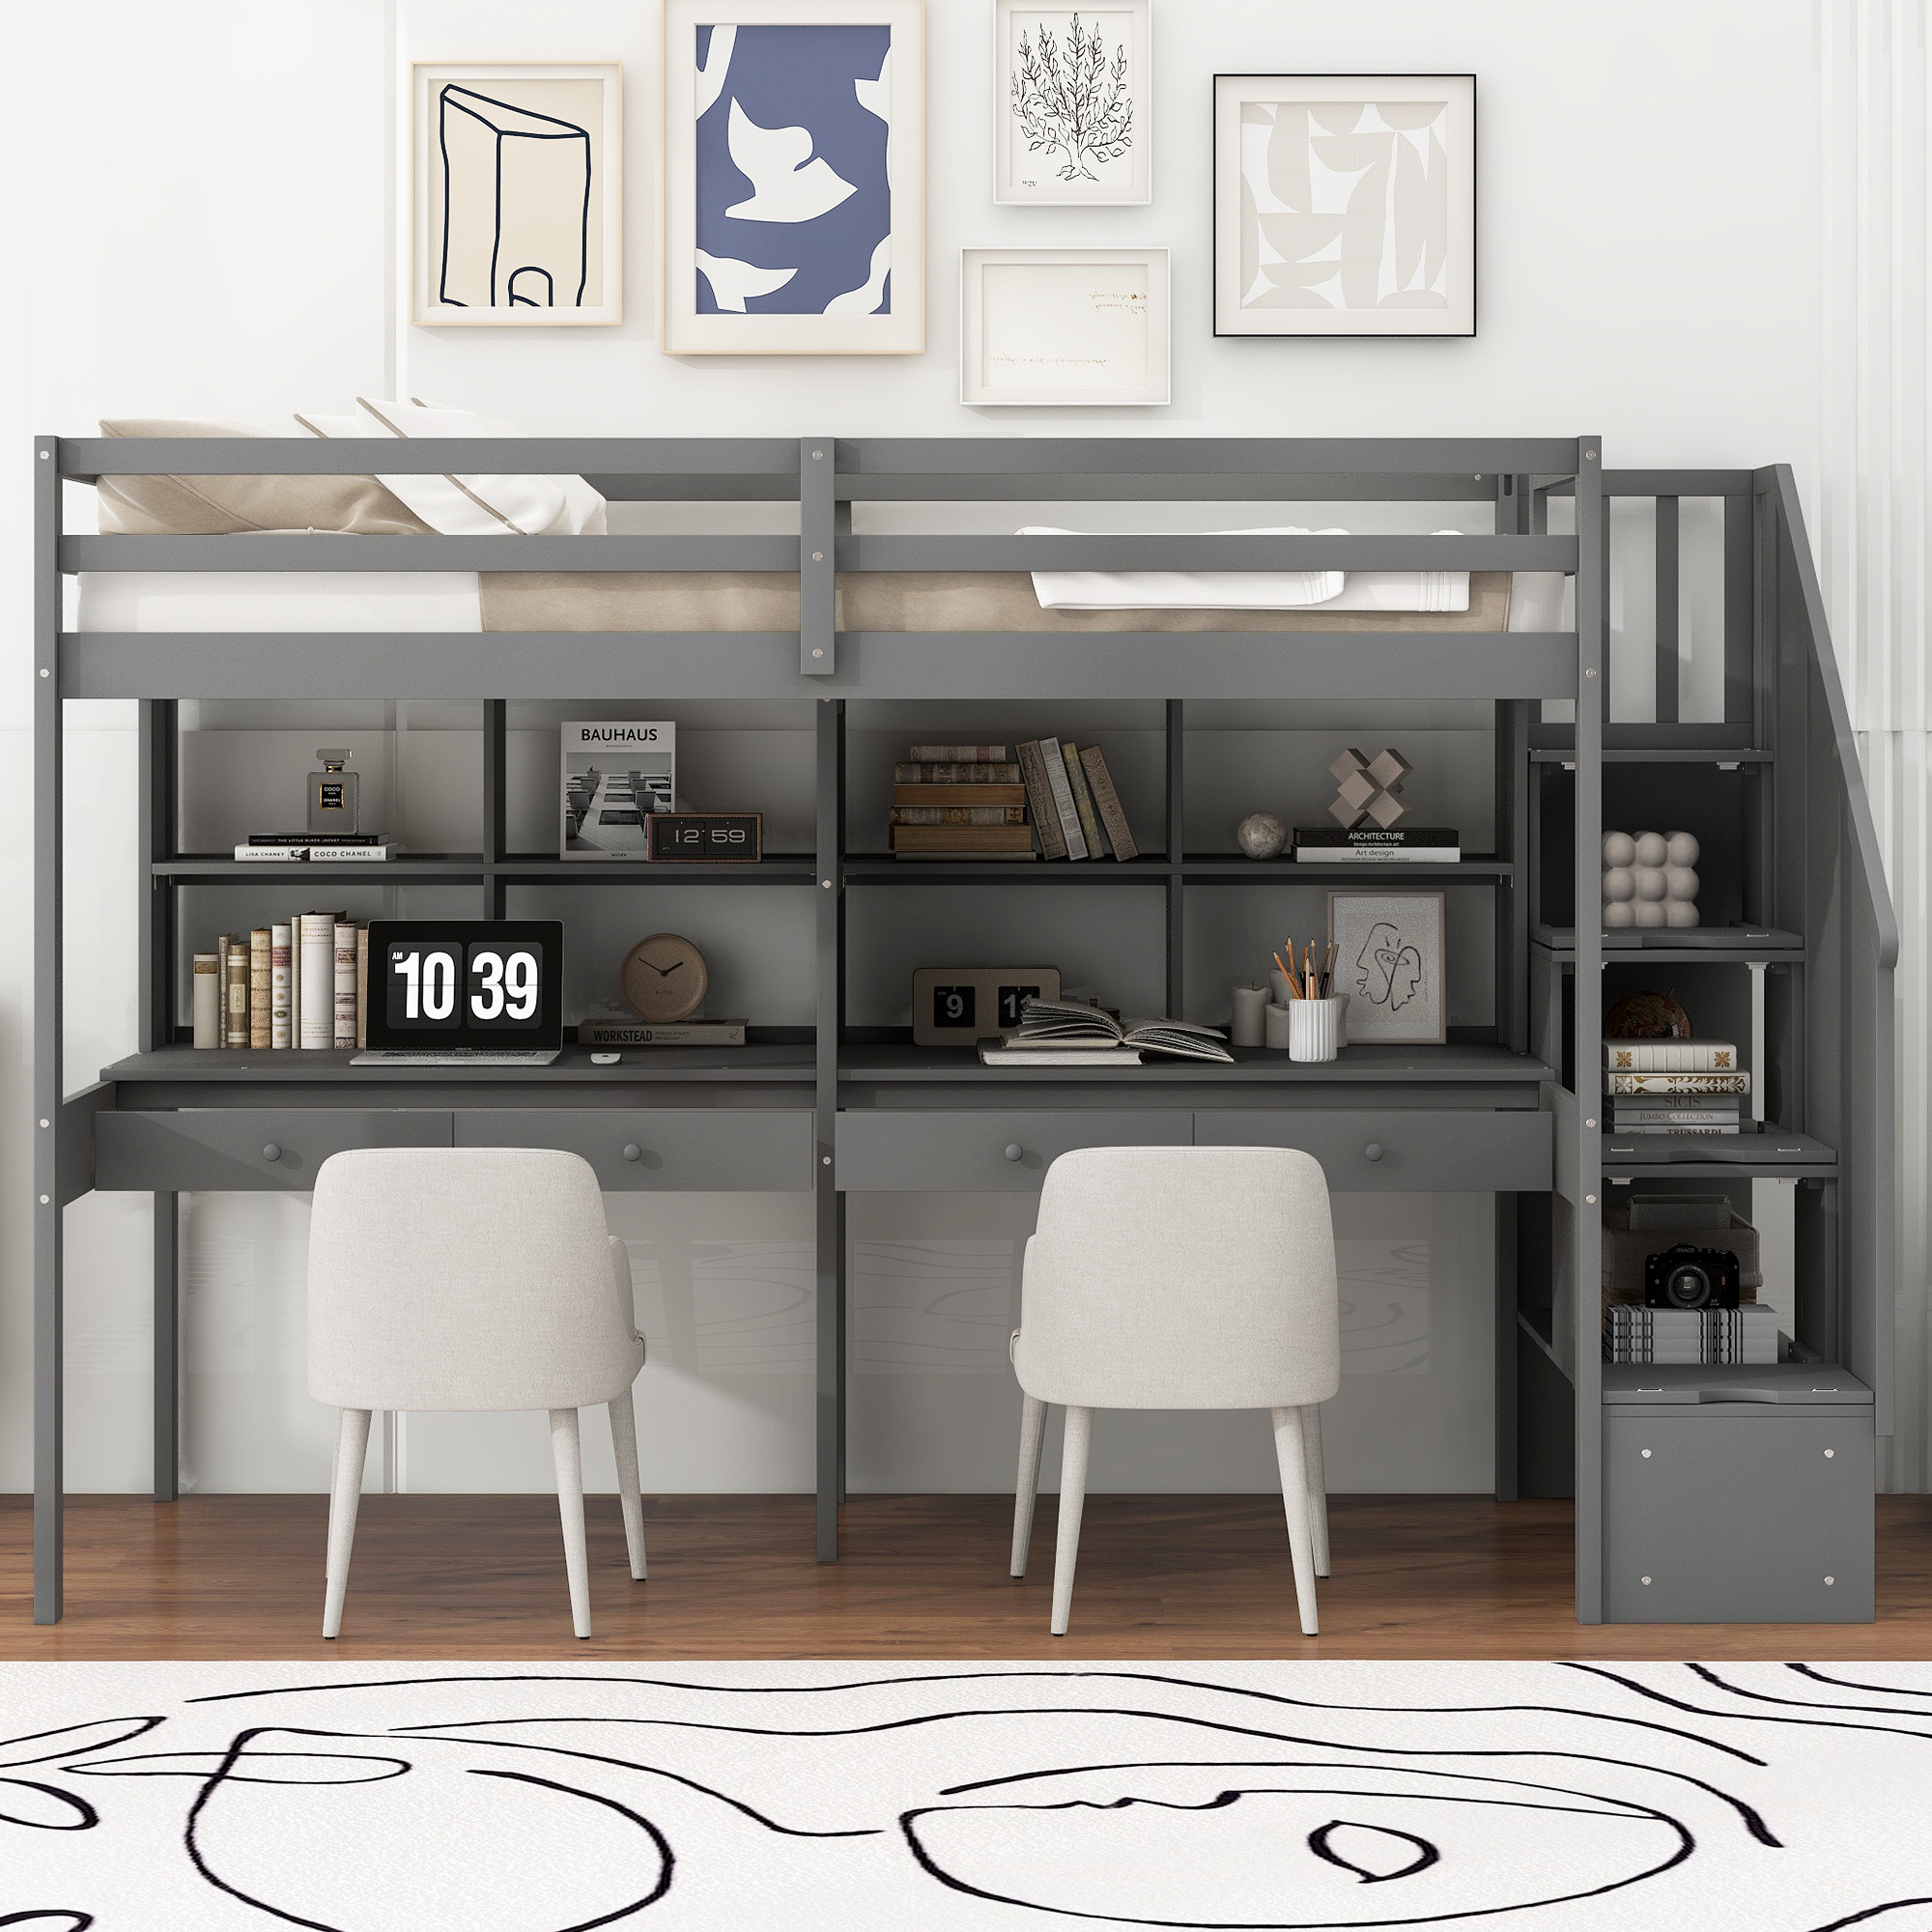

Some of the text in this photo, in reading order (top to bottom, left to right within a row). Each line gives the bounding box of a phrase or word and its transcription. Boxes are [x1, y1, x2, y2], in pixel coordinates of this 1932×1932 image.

[582, 728, 658, 741] BAUHAUS
[675, 829, 745, 843] 12 59
[1348, 832, 1405, 840] ARCHITECTURE
[392, 952, 403, 960] AM
[394, 951, 538, 1020] 10 39
[946, 994, 964, 1018] 9
[593, 1030, 653, 1041] WORKSTEAD
[1663, 1095, 1701, 1108] SICIS
[1639, 1112, 1714, 1122] JUMBO COLLECTION
